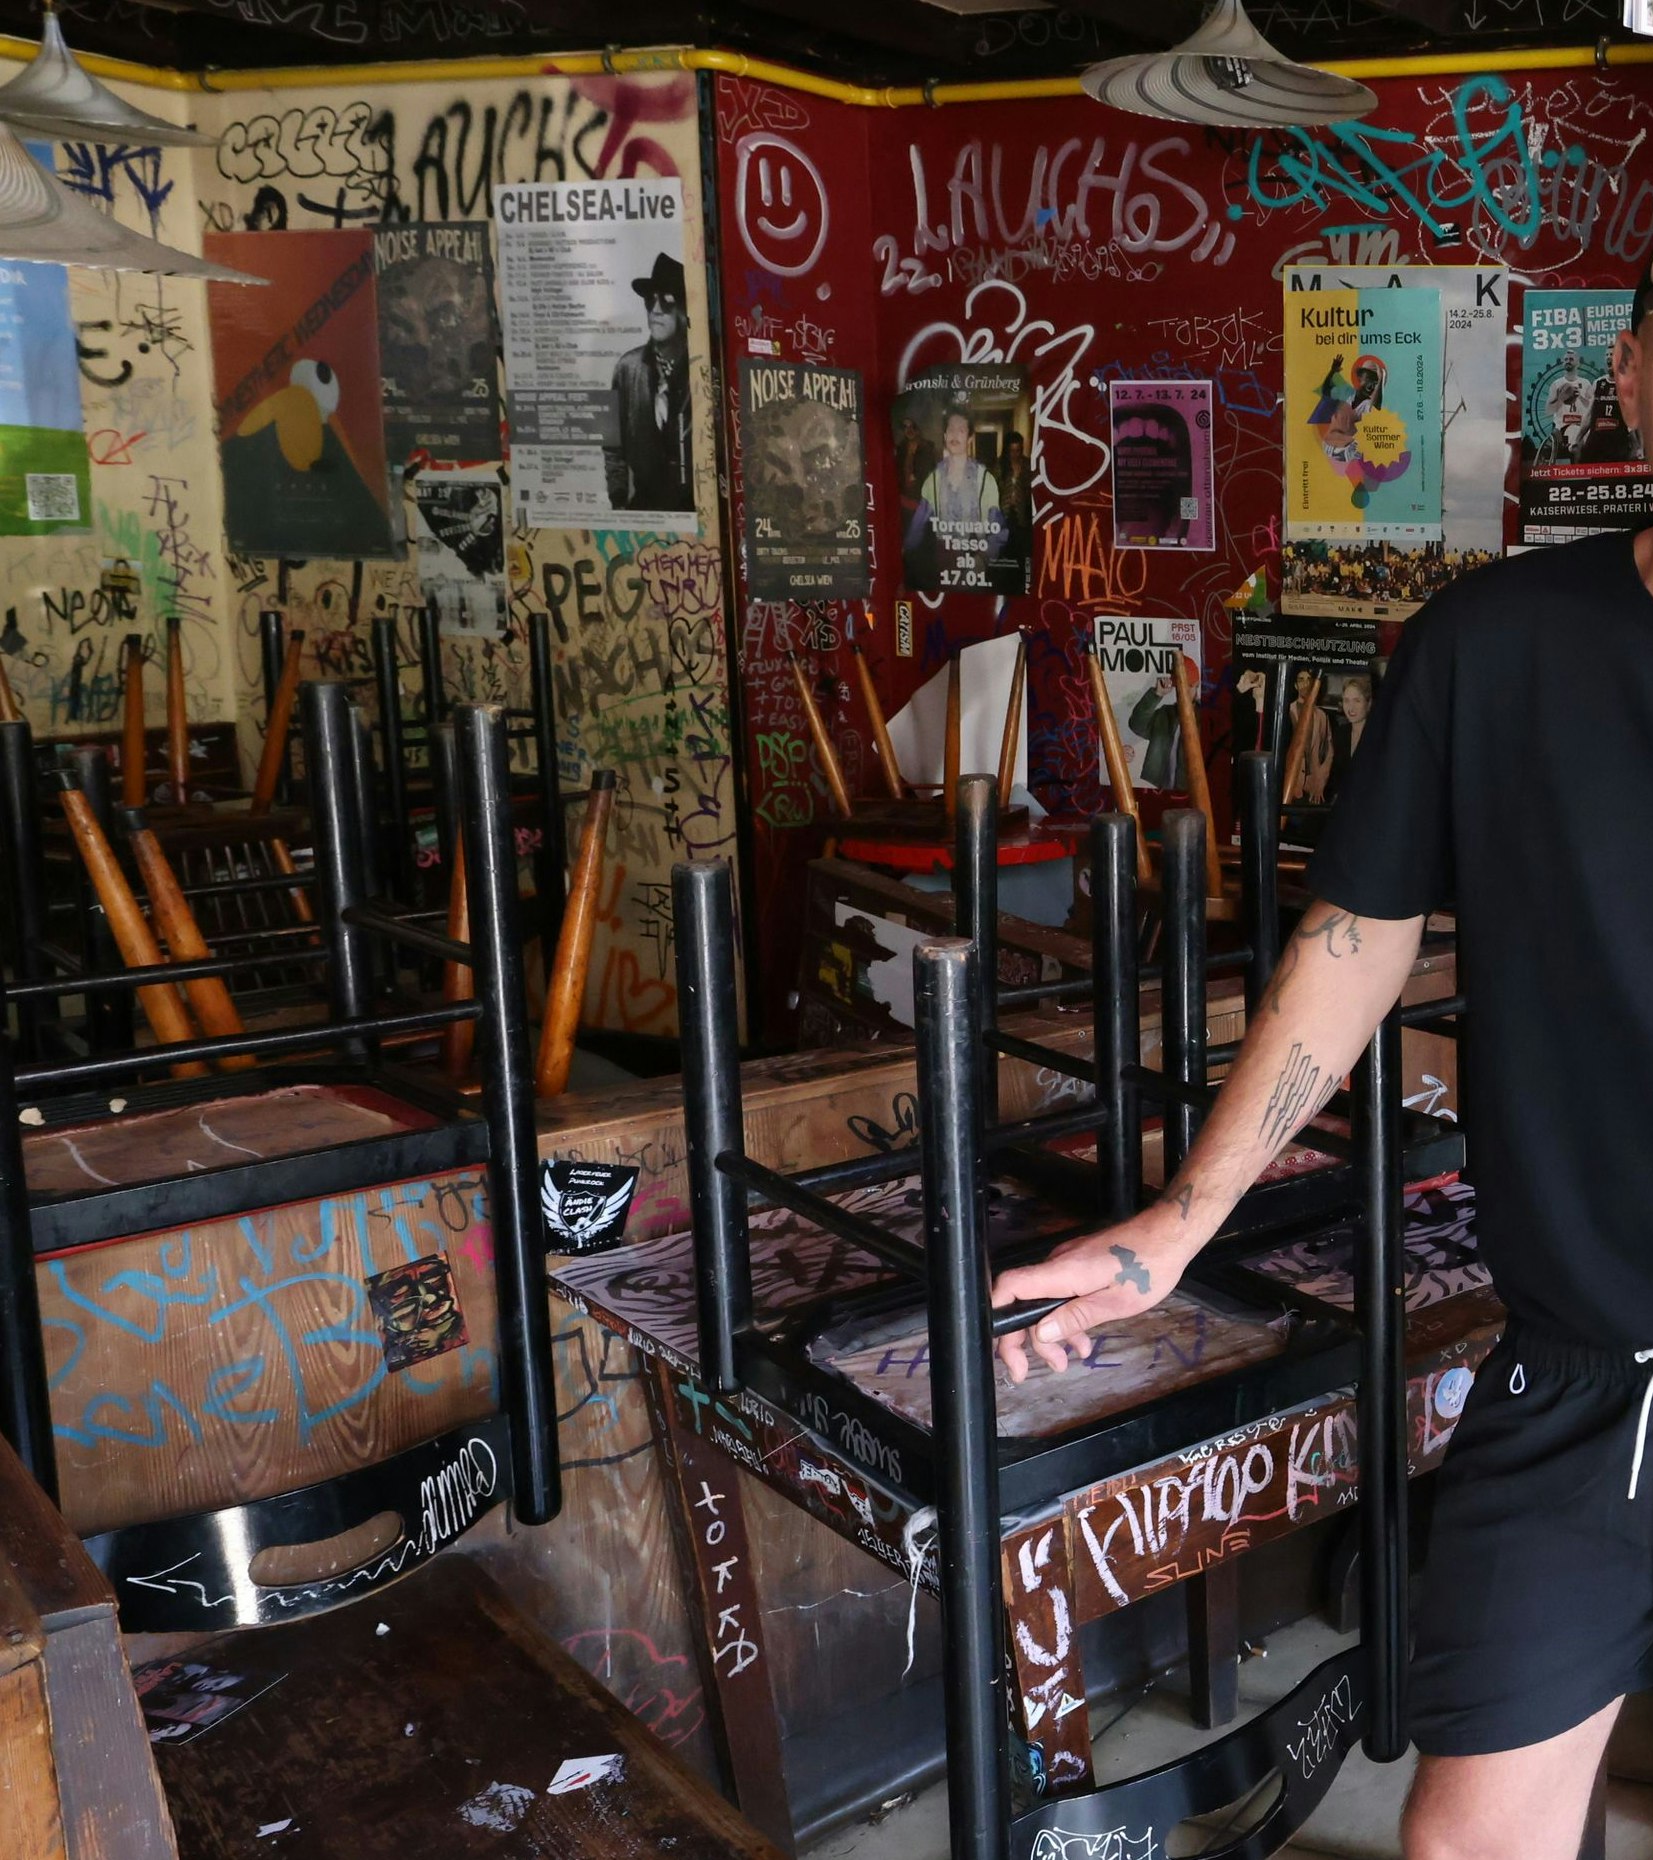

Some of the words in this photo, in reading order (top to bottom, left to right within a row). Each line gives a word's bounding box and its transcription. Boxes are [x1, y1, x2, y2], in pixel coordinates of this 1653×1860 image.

[500, 187, 676, 224] CHELSEA-Live
[1301, 306, 1374, 328] Kultur
[1531, 307, 1582, 326] FIBA
[1449, 320, 1472, 329] 2024
[1315, 333, 1335, 345] bei
[1338, 332, 1357, 345] dir
[1360, 331, 1392, 344] ums
[1395, 331, 1422, 344] Eck
[1532, 328, 1583, 350] 3x3
[750, 369, 795, 412] NOISE
[1115, 390, 1132, 400] 12.
[1136, 390, 1145, 400] 7.
[1155, 390, 1172, 400] 13.
[1190, 389, 1207, 400] 24
[1366, 433, 1400, 441] Sommer
[1374, 441, 1395, 449] Wien
[1530, 468, 1550, 477] Jetzt
[1553, 467, 1584, 476] Tickets
[1603, 505, 1642, 513] PRATER
[756, 518, 771, 538] 24
[929, 516, 1000, 534] Torquato
[942, 535, 988, 552] Tasso
[956, 554, 975, 569] ab
[940, 571, 992, 587] 17.01.
[1171, 623, 1195, 632] PRST
[1099, 622, 1183, 650] PAUL
[563, 1205, 593, 1216] CLASH
